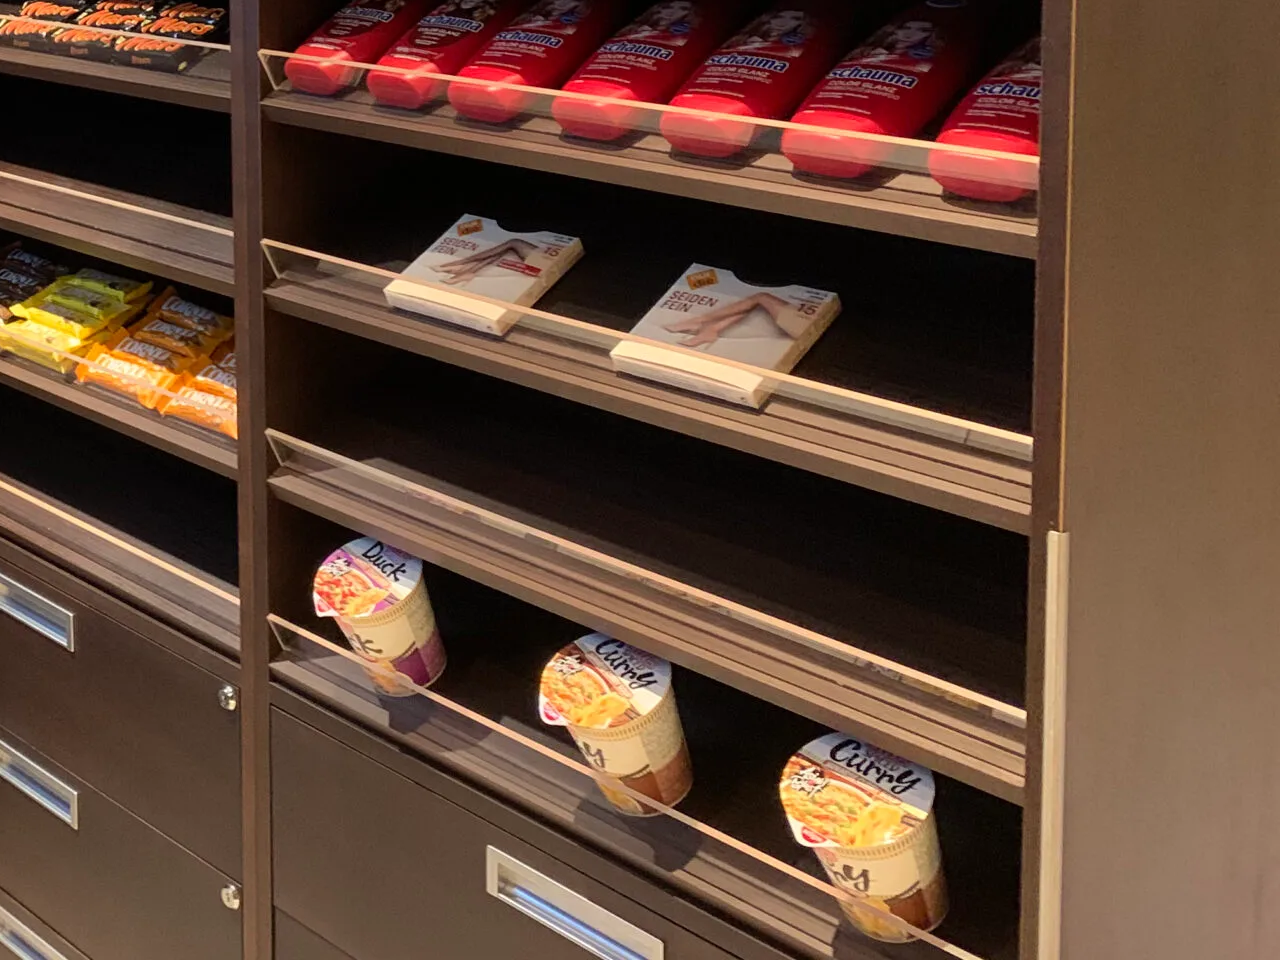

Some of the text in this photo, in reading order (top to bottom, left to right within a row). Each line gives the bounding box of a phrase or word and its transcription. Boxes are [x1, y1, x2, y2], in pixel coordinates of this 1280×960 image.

[496, 32, 562, 47] schauma
[602, 42, 672, 60] schauma
[708, 54, 788, 73] schauma
[830, 67, 917, 88] schauma
[979, 82, 1039, 98] schau
[441, 237, 479, 251] SEIDEN
[544, 247, 561, 257] 15
[660, 299, 693, 312] FEIN
[670, 290, 719, 307] SEIDEN
[797, 303, 819, 315] 15
[196, 365, 236, 386] CORN
[362, 540, 407, 582] Duck
[595, 640, 658, 690] Curry
[829, 739, 922, 795] Curry
